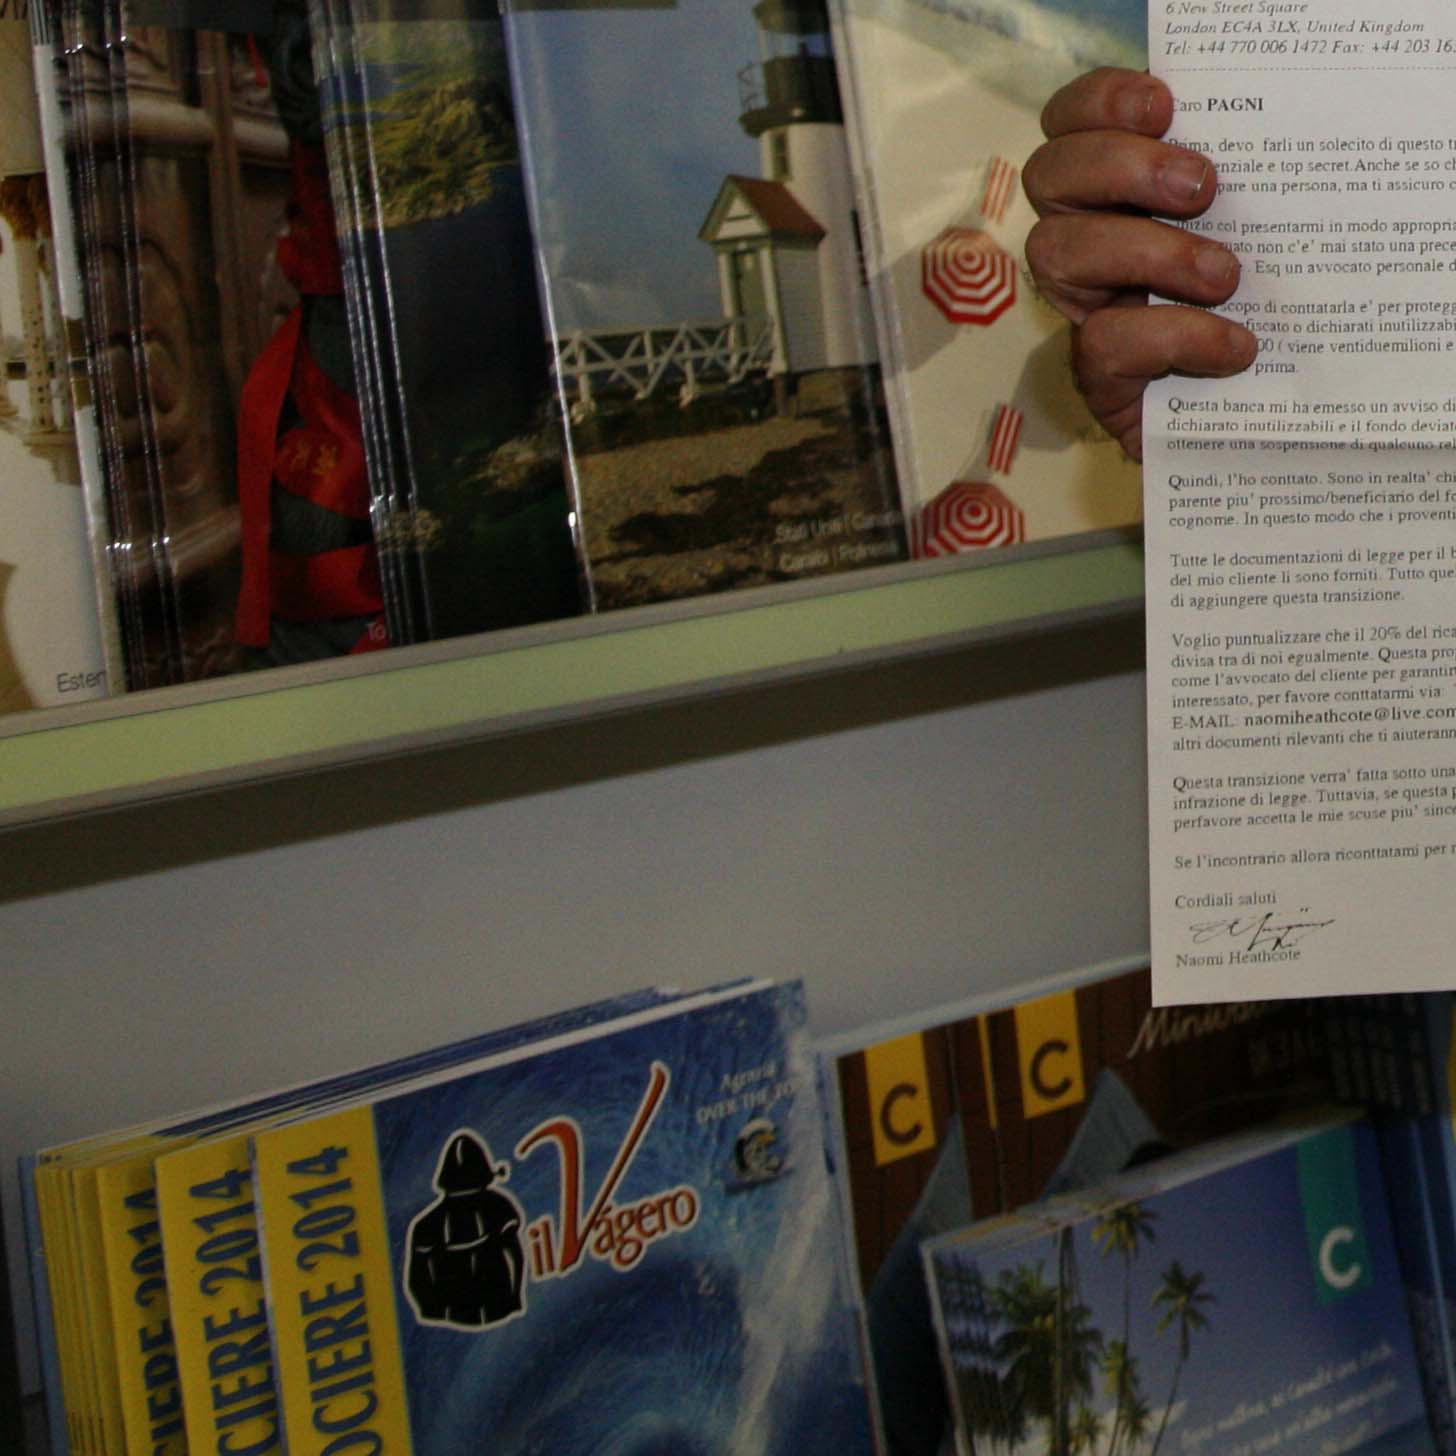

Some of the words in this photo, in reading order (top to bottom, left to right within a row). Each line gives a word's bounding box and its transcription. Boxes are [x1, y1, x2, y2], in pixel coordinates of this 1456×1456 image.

[1165, 0, 1174, 15] 6
[1177, 1, 1206, 15] New
[1213, 0, 1254, 14] Street
[1258, 0, 1308, 17] Square
[1164, 19, 1216, 35] London
[1221, 19, 1262, 34] EC4A
[1306, 18, 1356, 33] United
[1358, 18, 1424, 36] Kingdom
[1164, 39, 1191, 55] Tel:
[1197, 39, 1225, 54] +44
[1230, 38, 1257, 54] 770
[1259, 38, 1288, 54] 006
[1291, 38, 1328, 54] 1472
[1331, 39, 1364, 54] Fax:
[1371, 38, 1400, 53] +44
[1403, 38, 1430, 53] 203
[1206, 96, 1264, 112] PAGNI
[1217, 137, 1254, 152] devo
[1262, 136, 1292, 152] farli
[1295, 139, 1314, 152] un
[1318, 135, 1375, 152] solecito
[1378, 135, 1392, 151] di
[1396, 138, 1444, 155] questo
[1254, 259, 1280, 278] Esq
[1284, 263, 1303, 275] un
[1306, 261, 1372, 274] avvocato
[1375, 257, 1444, 276] personale
[1167, 395, 1218, 415] Questa
[1222, 397, 1265, 414] banca
[1268, 399, 1287, 414] mi
[1291, 399, 1309, 414] ha
[1312, 402, 1366, 414] emesso
[1369, 401, 1388, 413] un
[1392, 399, 1439, 413] avviso
[1441, 397, 1456, 413] di
[1172, 693, 1253, 709] interessato,
[1256, 693, 1281, 709] per
[1284, 689, 1330, 704] favore
[1333, 684, 1414, 702] conttatarmi
[1173, 814, 1242, 833] perfavore
[1246, 812, 1296, 825] accetta
[1300, 809, 1313, 823] le
[1317, 807, 1344, 823] mie
[1349, 809, 1386, 820] scuse
[1174, 855, 1192, 869] Se
[1196, 853, 1286, 868] l'incontrario
[1290, 848, 1330, 864] allora
[1335, 843, 1419, 861] riconttatami
[1423, 844, 1446, 859] per
[1174, 892, 1233, 909] Cordiali
[1238, 890, 1276, 905] saluti
[1176, 953, 1223, 967] Naomi
[1228, 949, 1300, 965] Heathcote
[1029, 1039, 1072, 1103] C
[880, 1083, 923, 1147] C
[286, 1145, 360, 1272] 2014
[188, 1168, 262, 1296] 2014
[1318, 1225, 1361, 1291] C
